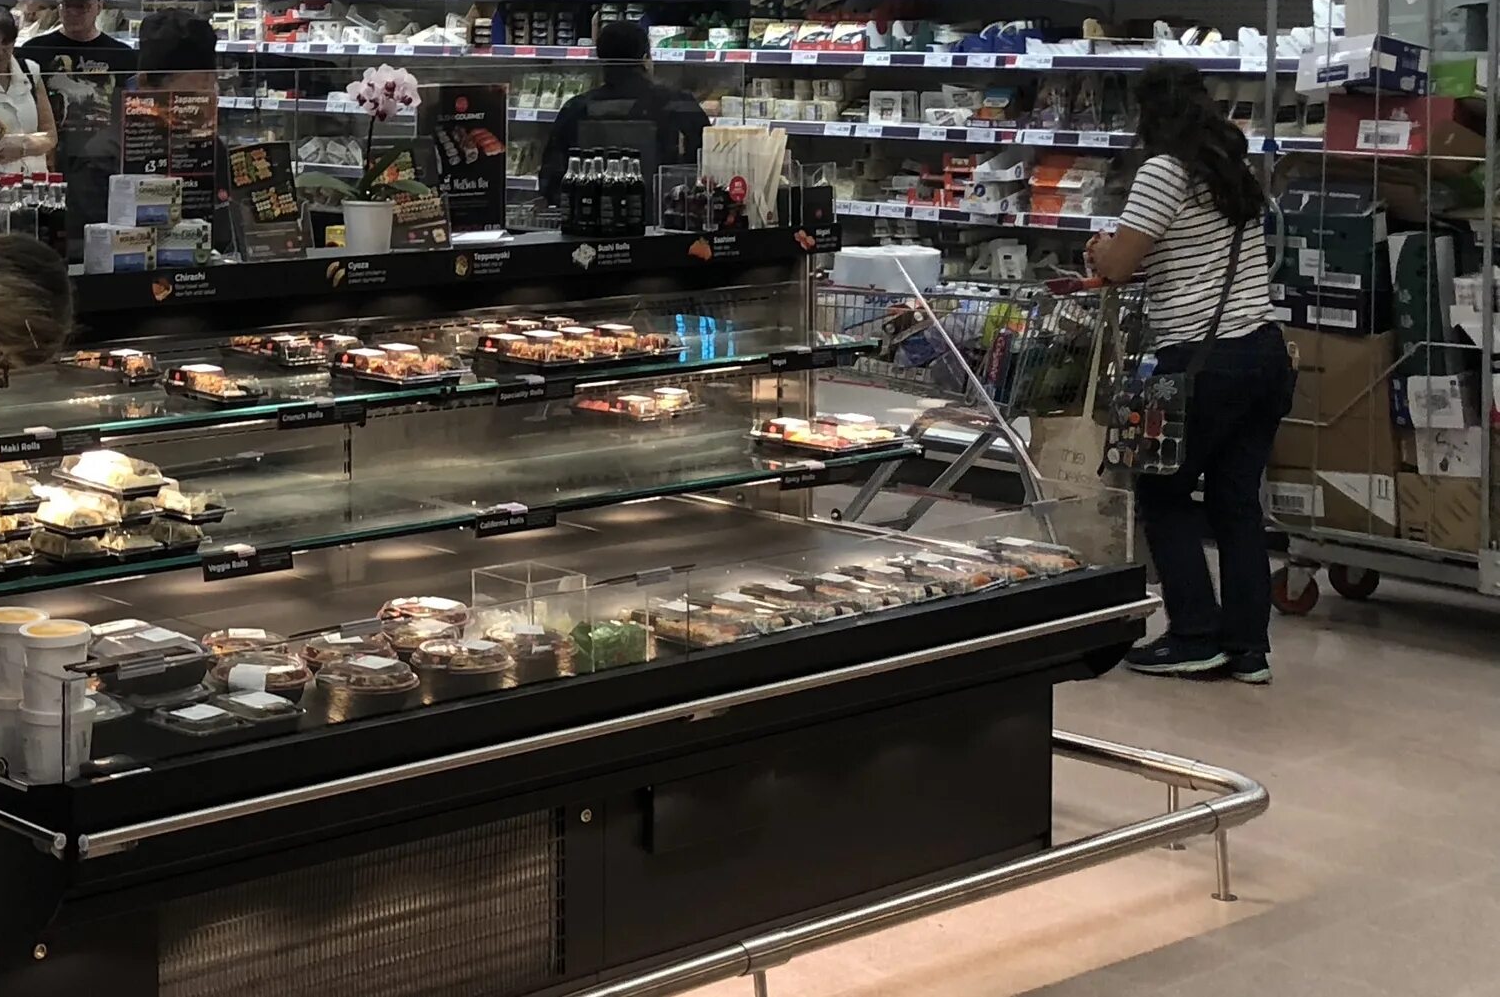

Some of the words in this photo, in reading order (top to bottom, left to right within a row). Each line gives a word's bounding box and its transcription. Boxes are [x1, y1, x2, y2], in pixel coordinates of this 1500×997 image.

[174, 271, 206, 282] Chirashi
[282, 412, 306, 422] Crunch
[0, 443, 20, 453] Maki
[21, 441, 41, 452] Rolls
[207, 561, 231, 573] Veggie
[232, 559, 249, 569] Rolls
